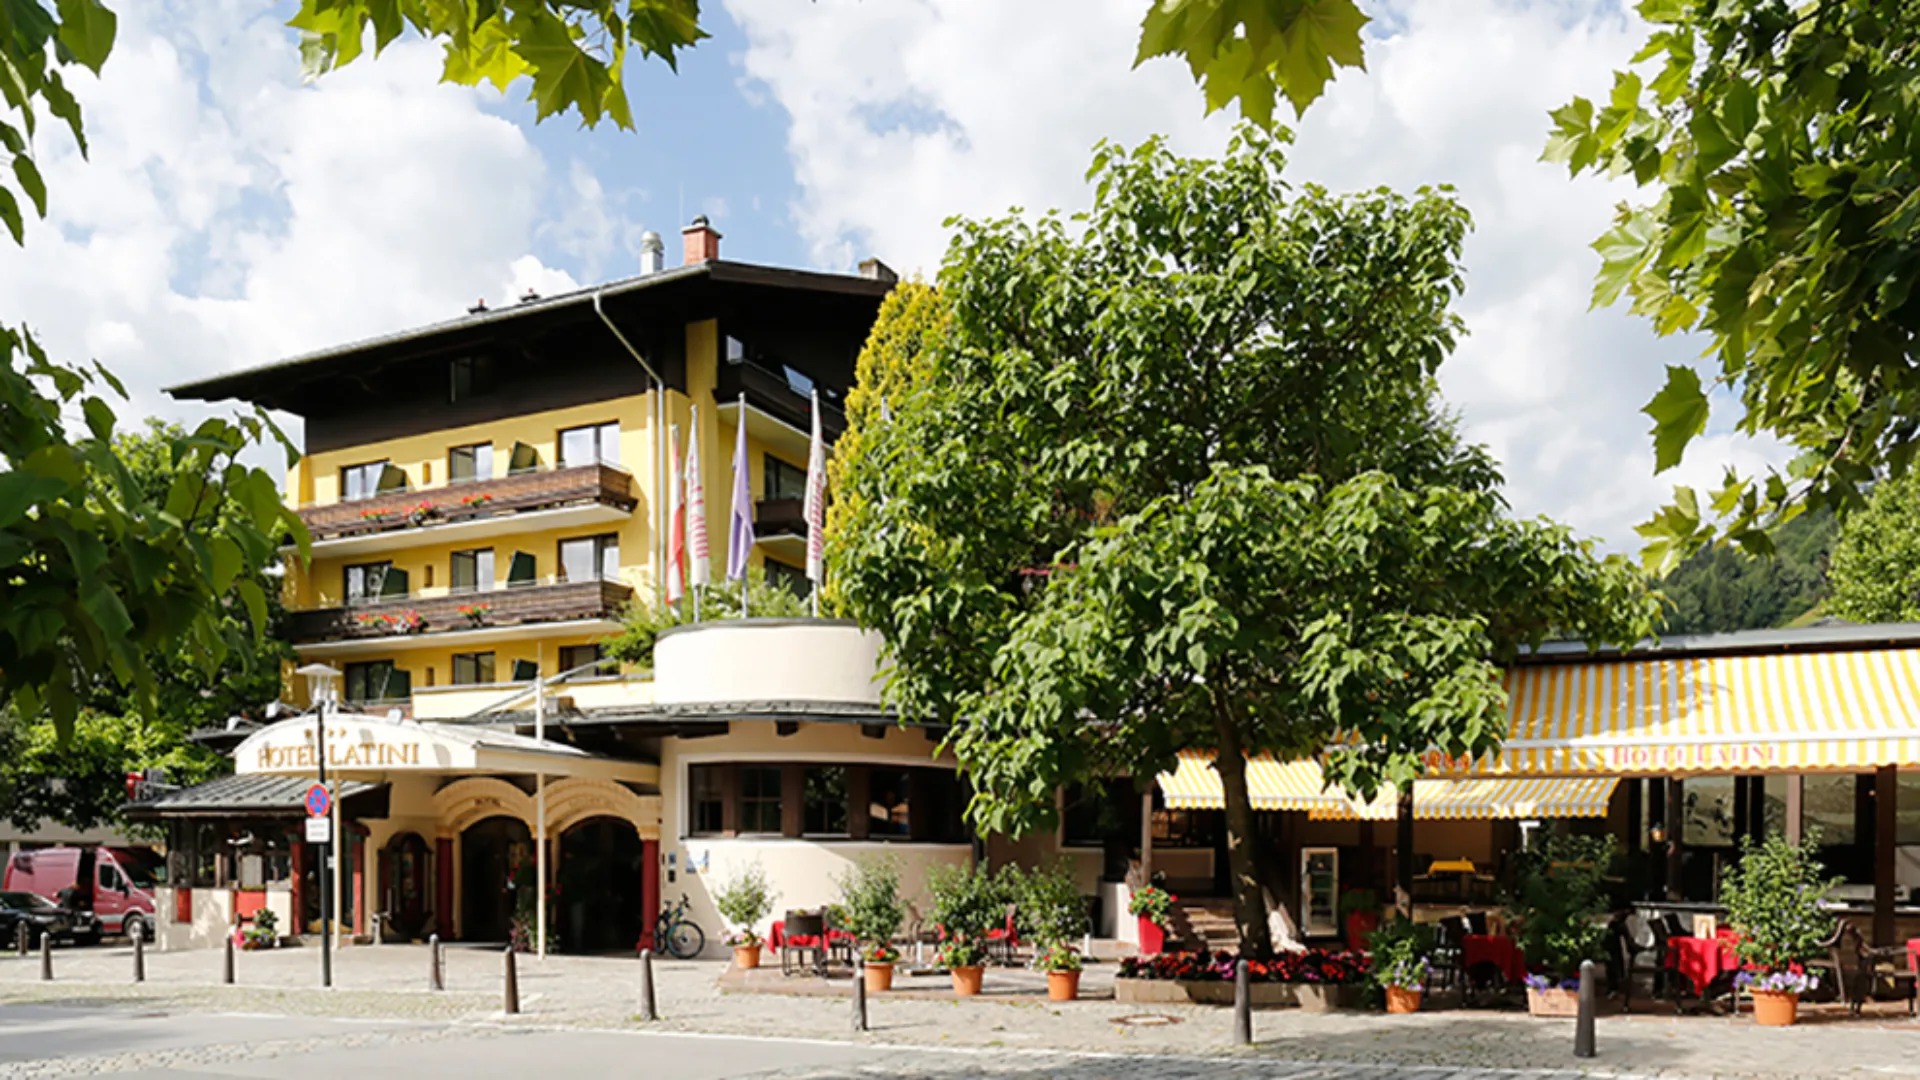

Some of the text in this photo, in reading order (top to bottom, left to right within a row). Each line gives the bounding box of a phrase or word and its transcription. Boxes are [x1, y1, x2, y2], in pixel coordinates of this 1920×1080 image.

[257, 743, 420, 768] HOTEL LATINI
[1612, 743, 1774, 766] HOTEL LATINI
